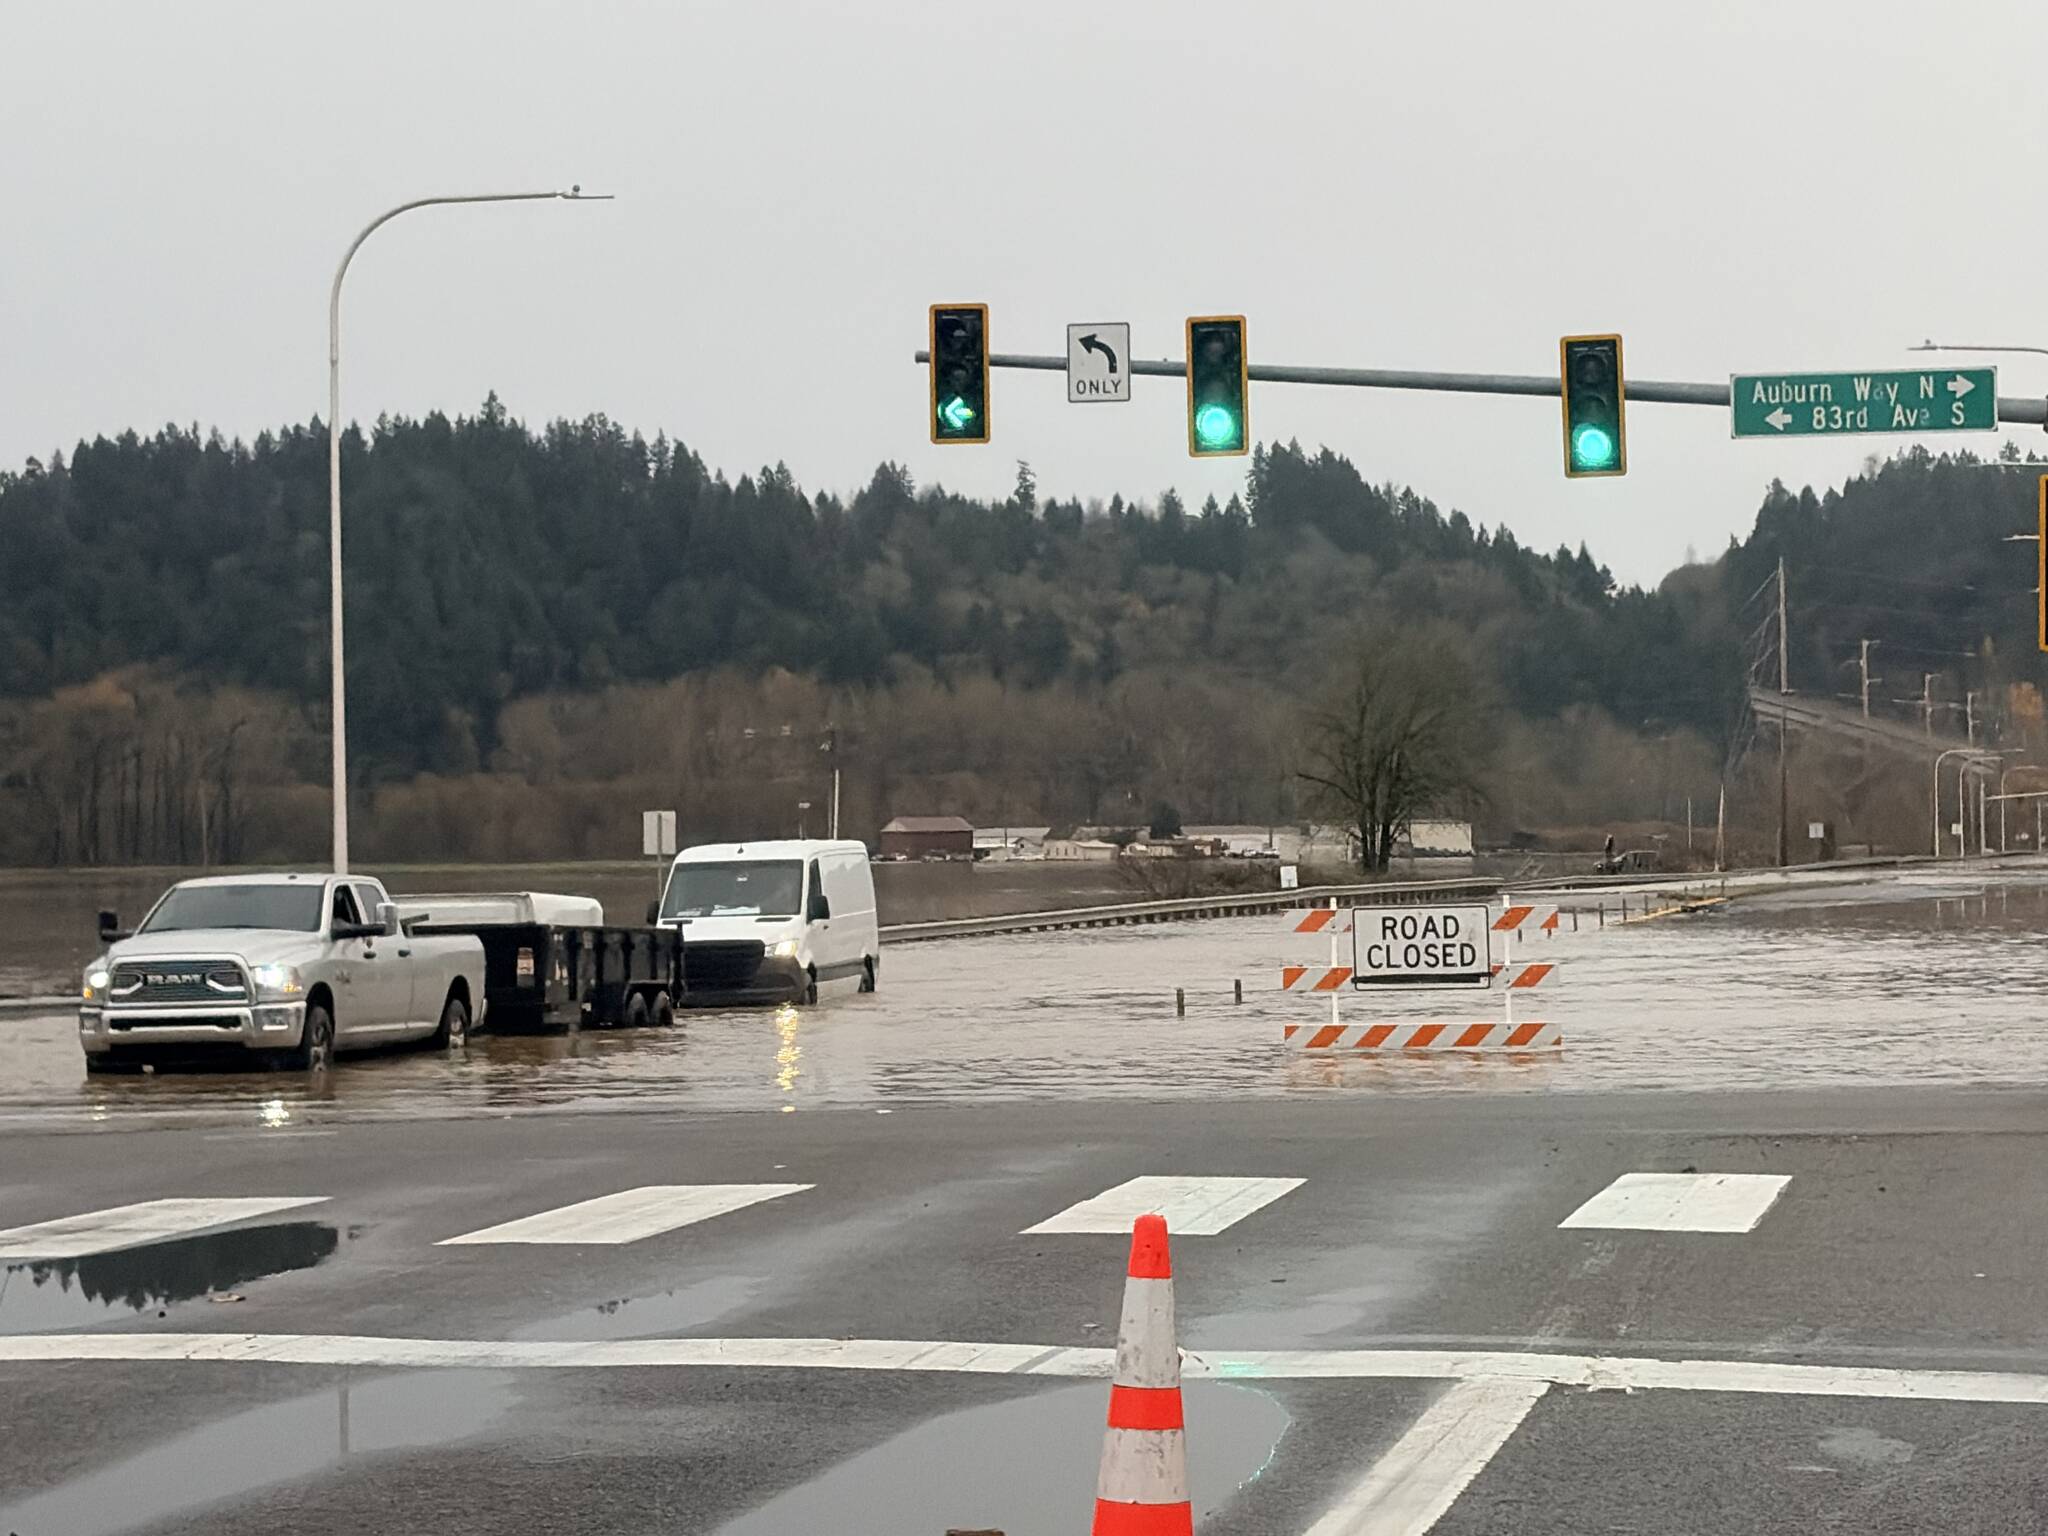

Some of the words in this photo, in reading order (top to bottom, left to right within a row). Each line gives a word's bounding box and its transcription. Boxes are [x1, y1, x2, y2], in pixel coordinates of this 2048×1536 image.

[1076, 379, 1121, 395] ONLY
[1752, 381, 1833, 404] Auburn
[1853, 377, 1899, 407] Way
[1920, 375, 1935, 399] N
[1812, 405, 1868, 429] 83rd
[1892, 404, 1931, 428] Ave
[1951, 402, 1965, 426] S
[1381, 915, 1460, 940] ROAD
[1366, 943, 1476, 969] CLOSED
[146, 973, 202, 985] RAM
